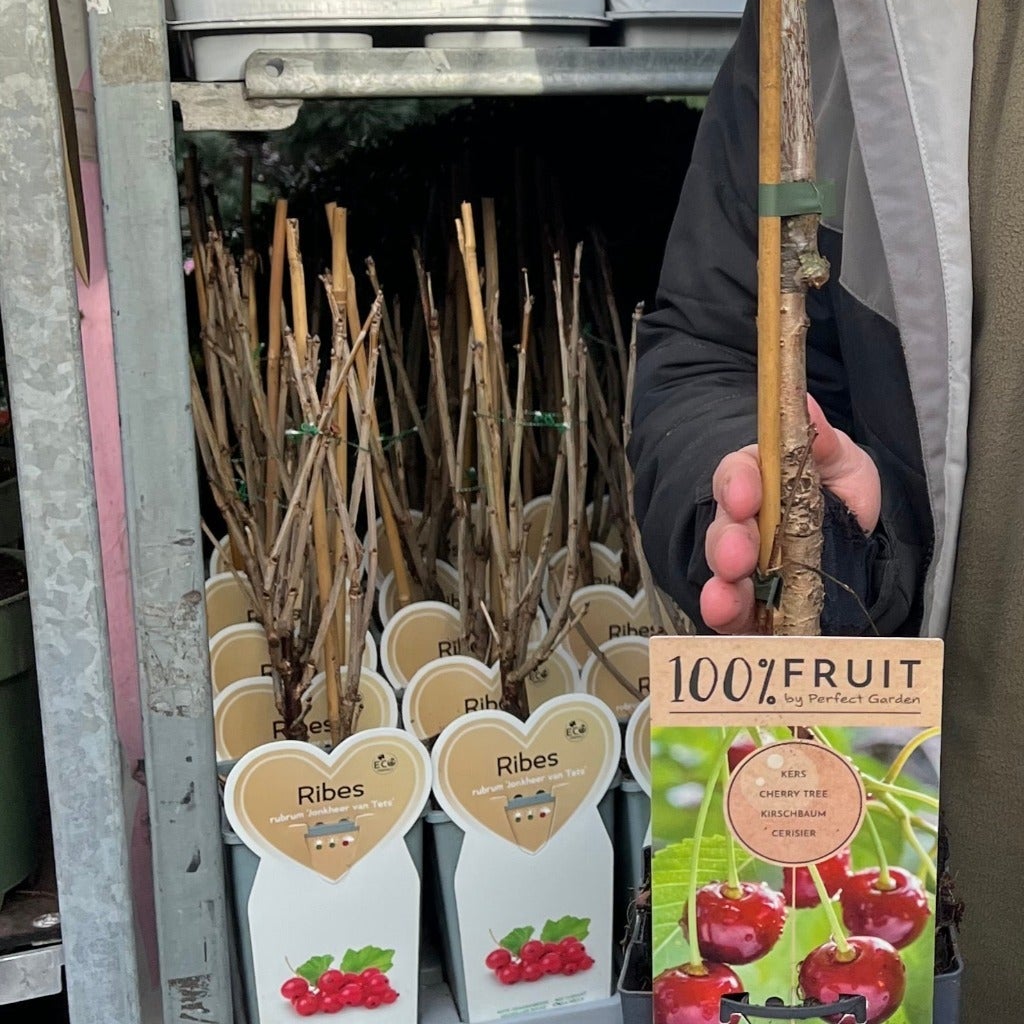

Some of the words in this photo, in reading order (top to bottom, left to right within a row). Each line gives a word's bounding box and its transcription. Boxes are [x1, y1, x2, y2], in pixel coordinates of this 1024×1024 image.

[669, 656, 776, 705] 100%
[784, 658, 922, 688] FRUIT
[784, 692, 804, 707] by
[808, 693, 864, 704] Perfect
[868, 692, 921, 704] Garden
[497, 752, 558, 777] Ribes
[781, 770, 807, 778] KERS
[472, 784, 504, 796] rubrum
[548, 772, 564, 781] van
[298, 782, 365, 805] Ribes
[759, 790, 800, 798] CHERRY
[803, 790, 828, 798] TREE
[269, 811, 305, 824] rubrum
[352, 802, 369, 811] van
[761, 810, 826, 818] KIRSCHBAUM
[771, 829, 816, 837] CERISIER
